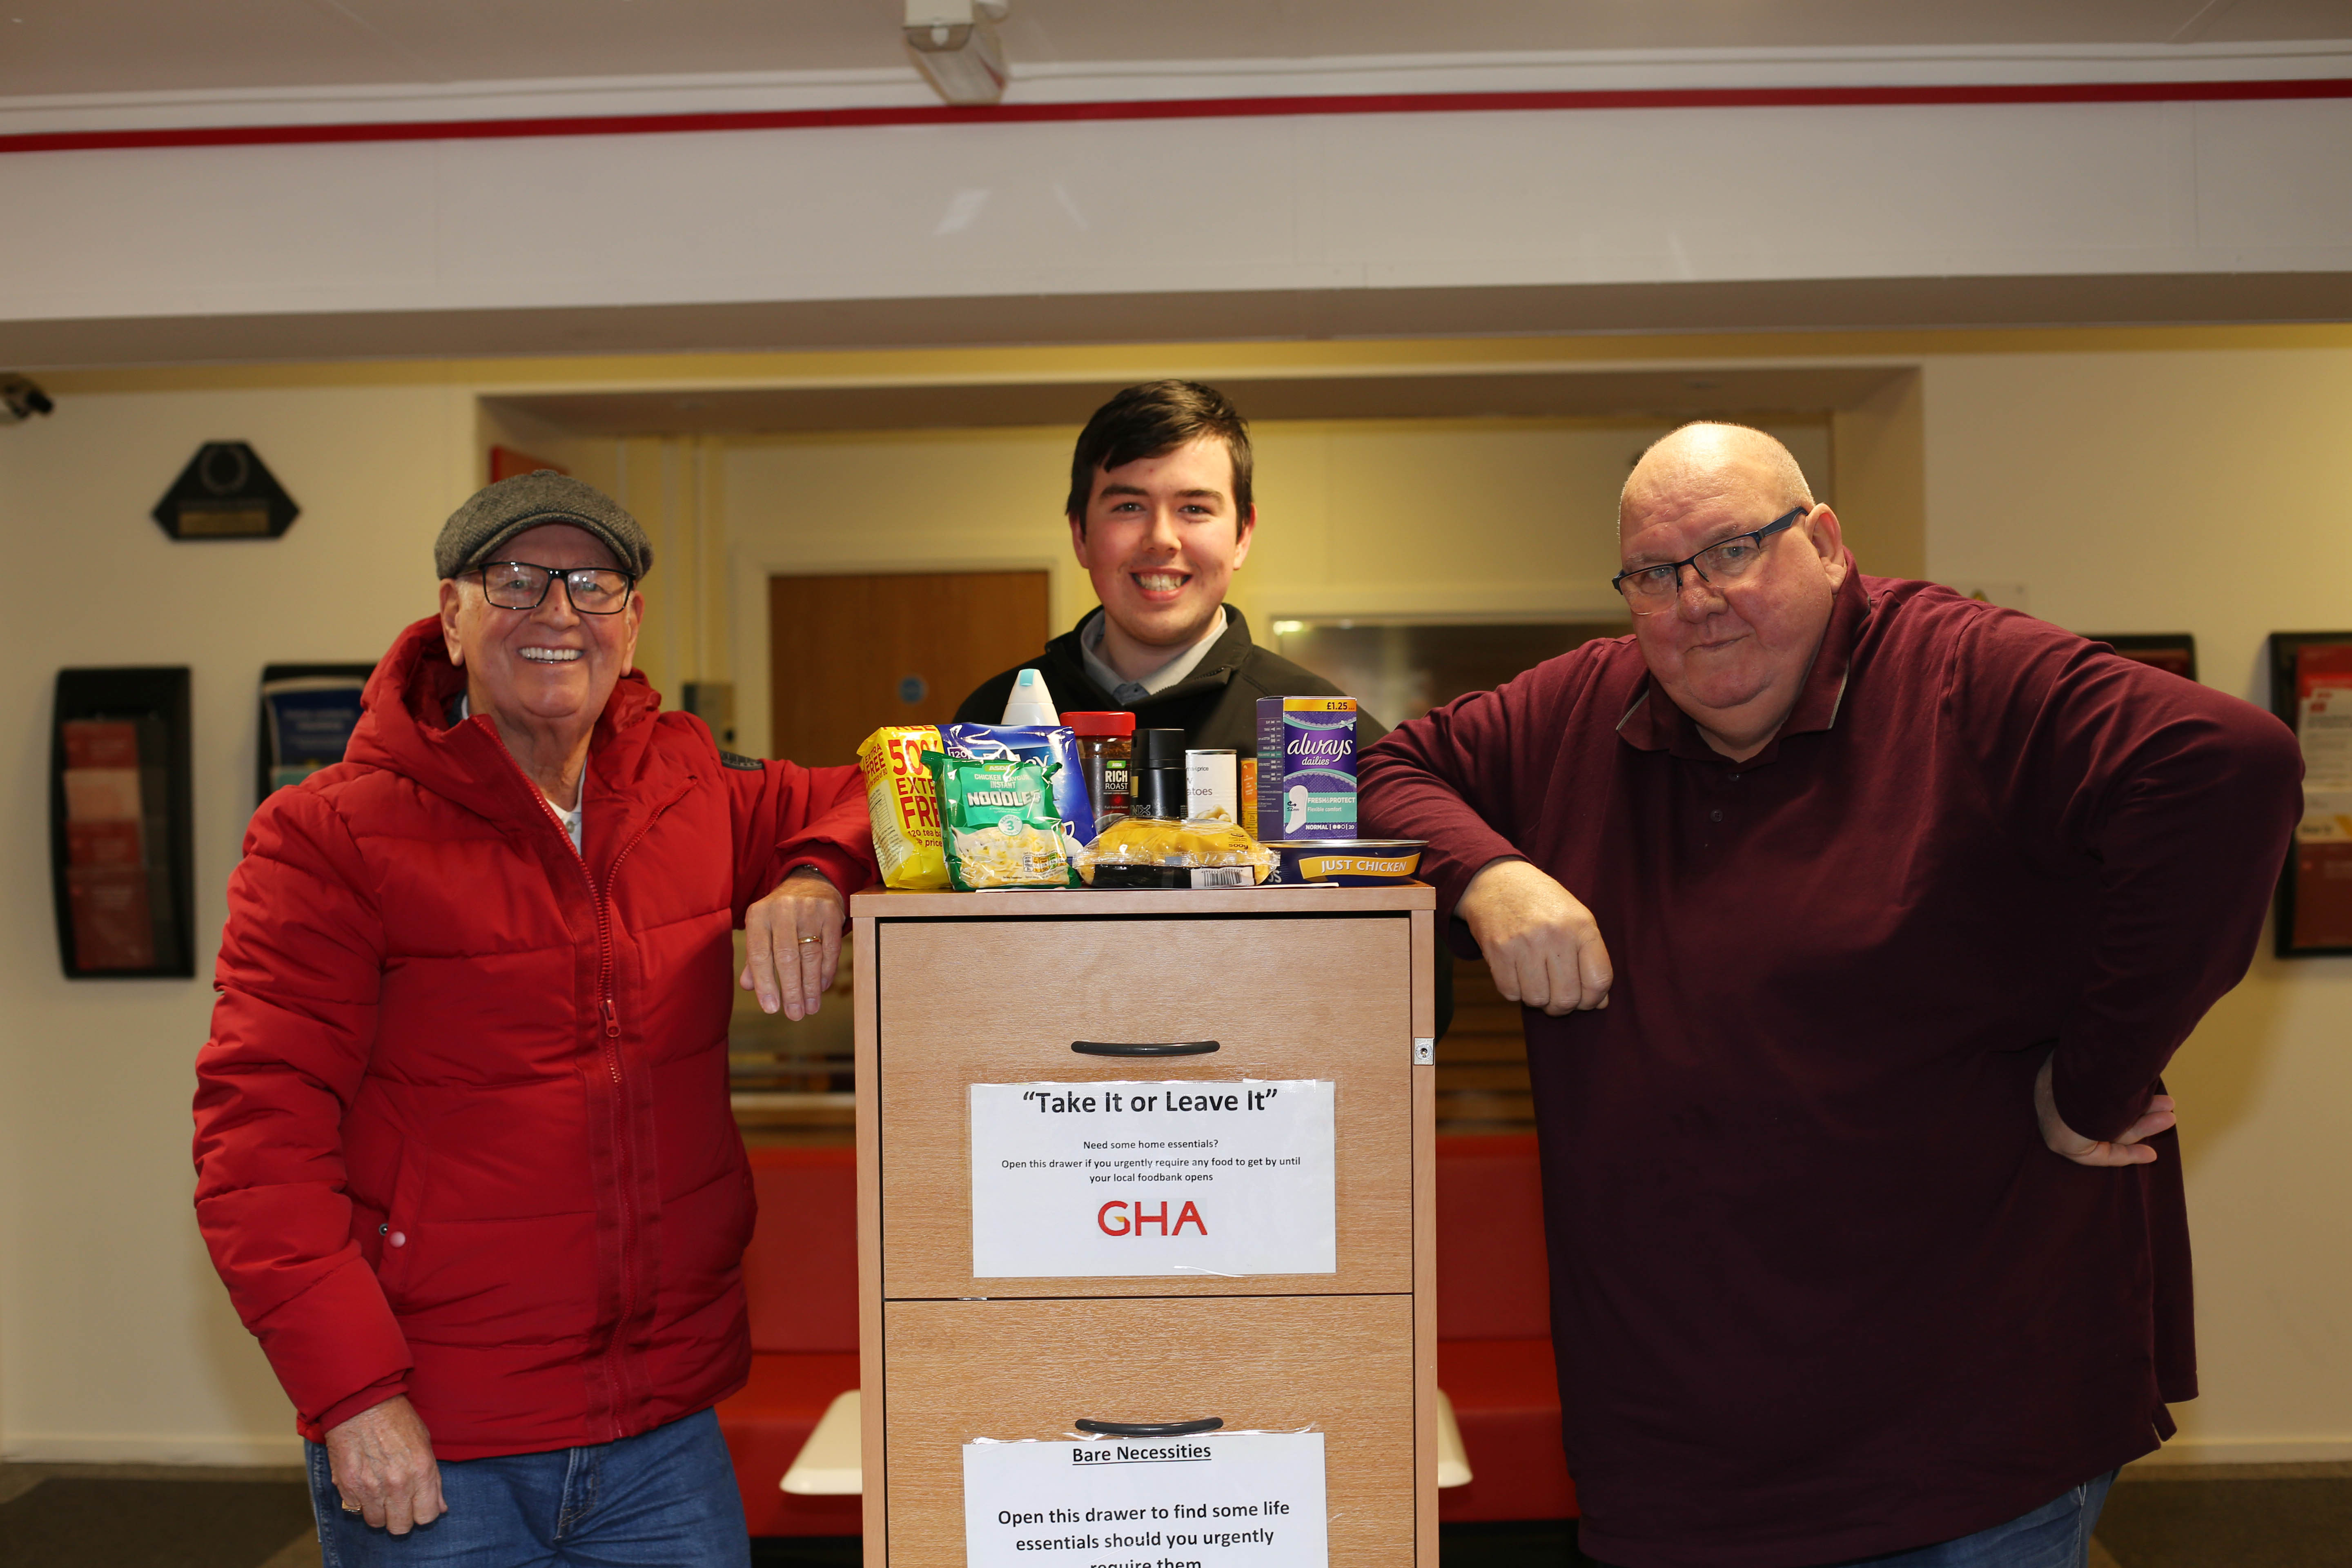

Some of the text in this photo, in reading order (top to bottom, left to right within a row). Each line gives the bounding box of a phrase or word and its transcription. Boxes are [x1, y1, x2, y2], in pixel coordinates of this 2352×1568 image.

[1327, 702, 1348, 710] £1.25
[865, 743, 882, 764] EXTRA
[1287, 732, 1353, 762] always
[866, 751, 886, 781] FREE
[1301, 755, 1330, 766] dailies
[1105, 770, 1128, 783] RICH
[895, 777, 935, 796] EXTR
[990, 781, 1016, 789] INSTANT
[967, 789, 1041, 807] NOODLES
[1186, 788, 1212, 796] atoes
[900, 795, 941, 829] FRE
[1132, 804, 1151, 816] NX
[1007, 820, 1015, 831] 3
[925, 838, 942, 848] price
[1321, 860, 1407, 873] JUST CHICKEN
[1131, 1096, 1158, 1112] or
[1167, 1091, 1238, 1111] Leave
[1083, 1141, 1108, 1149] Need
[1138, 1140, 1165, 1149] home
[1168, 1139, 1218, 1148] essentials?
[1001, 1160, 1027, 1170] Open
[1029, 1159, 1047, 1168] this
[1049, 1159, 1083, 1168] drawer
[1085, 1158, 1092, 1167] if
[1094, 1161, 1111, 1169] you
[1114, 1158, 1153, 1169] urgently
[1155, 1158, 1189, 1168] require
[1192, 1159, 1209, 1168] any
[1211, 1157, 1233, 1166] food
[1248, 1158, 1263, 1168] get
[1265, 1157, 1277, 1167] by
[1279, 1157, 1301, 1165] until
[1089, 1173, 1213, 1184] your local foodbank opens
[1097, 1200, 1208, 1237] GHA
[1072, 1444, 1211, 1463] Bare Necessities
[998, 1501, 1290, 1527] Open this drawer to find some life
[1016, 1528, 1274, 1551] essentials should you urgently
[1157, 1558, 1201, 1568] them
